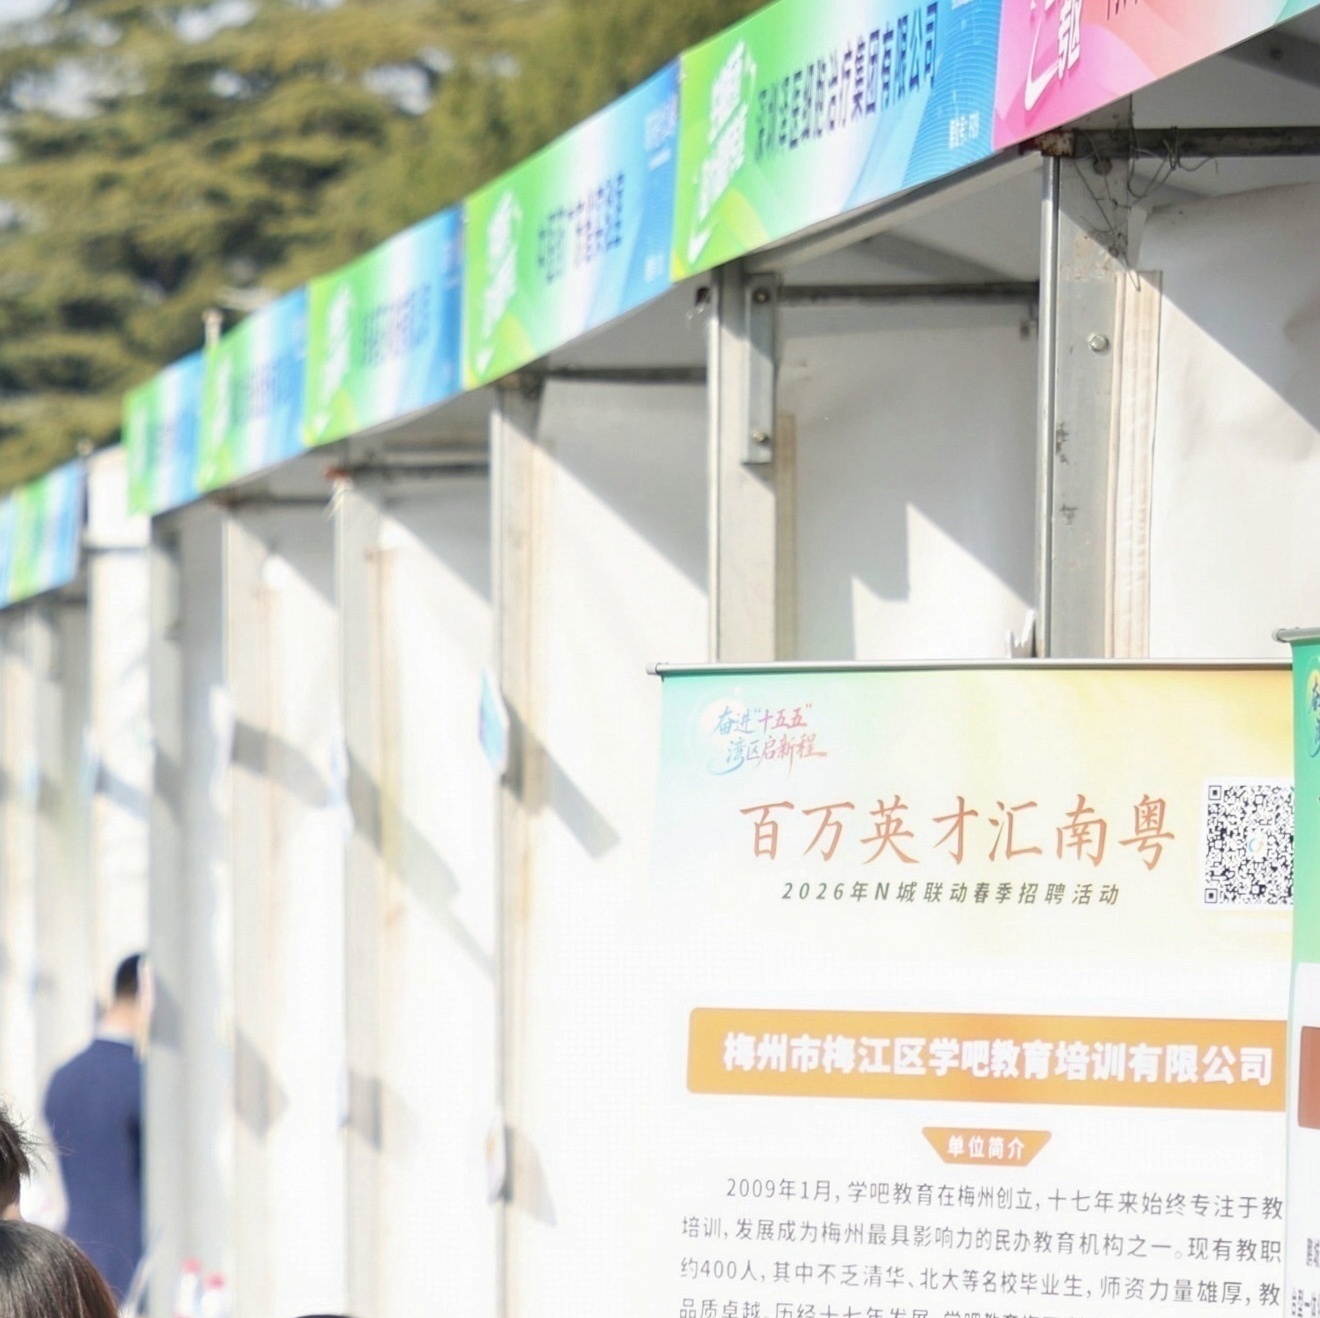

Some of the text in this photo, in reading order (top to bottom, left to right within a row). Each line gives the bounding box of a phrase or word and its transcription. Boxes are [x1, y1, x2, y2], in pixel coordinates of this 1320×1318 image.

[709, 733, 829, 778] 湾区启新程
[738, 793, 1177, 871] 百万英才汇南粤
[781, 879, 1121, 907] 2026年N城联动春季招聘活动
[722, 1031, 1273, 1086] 梅州市梅江区学吧教育培训有限公司
[946, 1133, 1027, 1162] 单位简介
